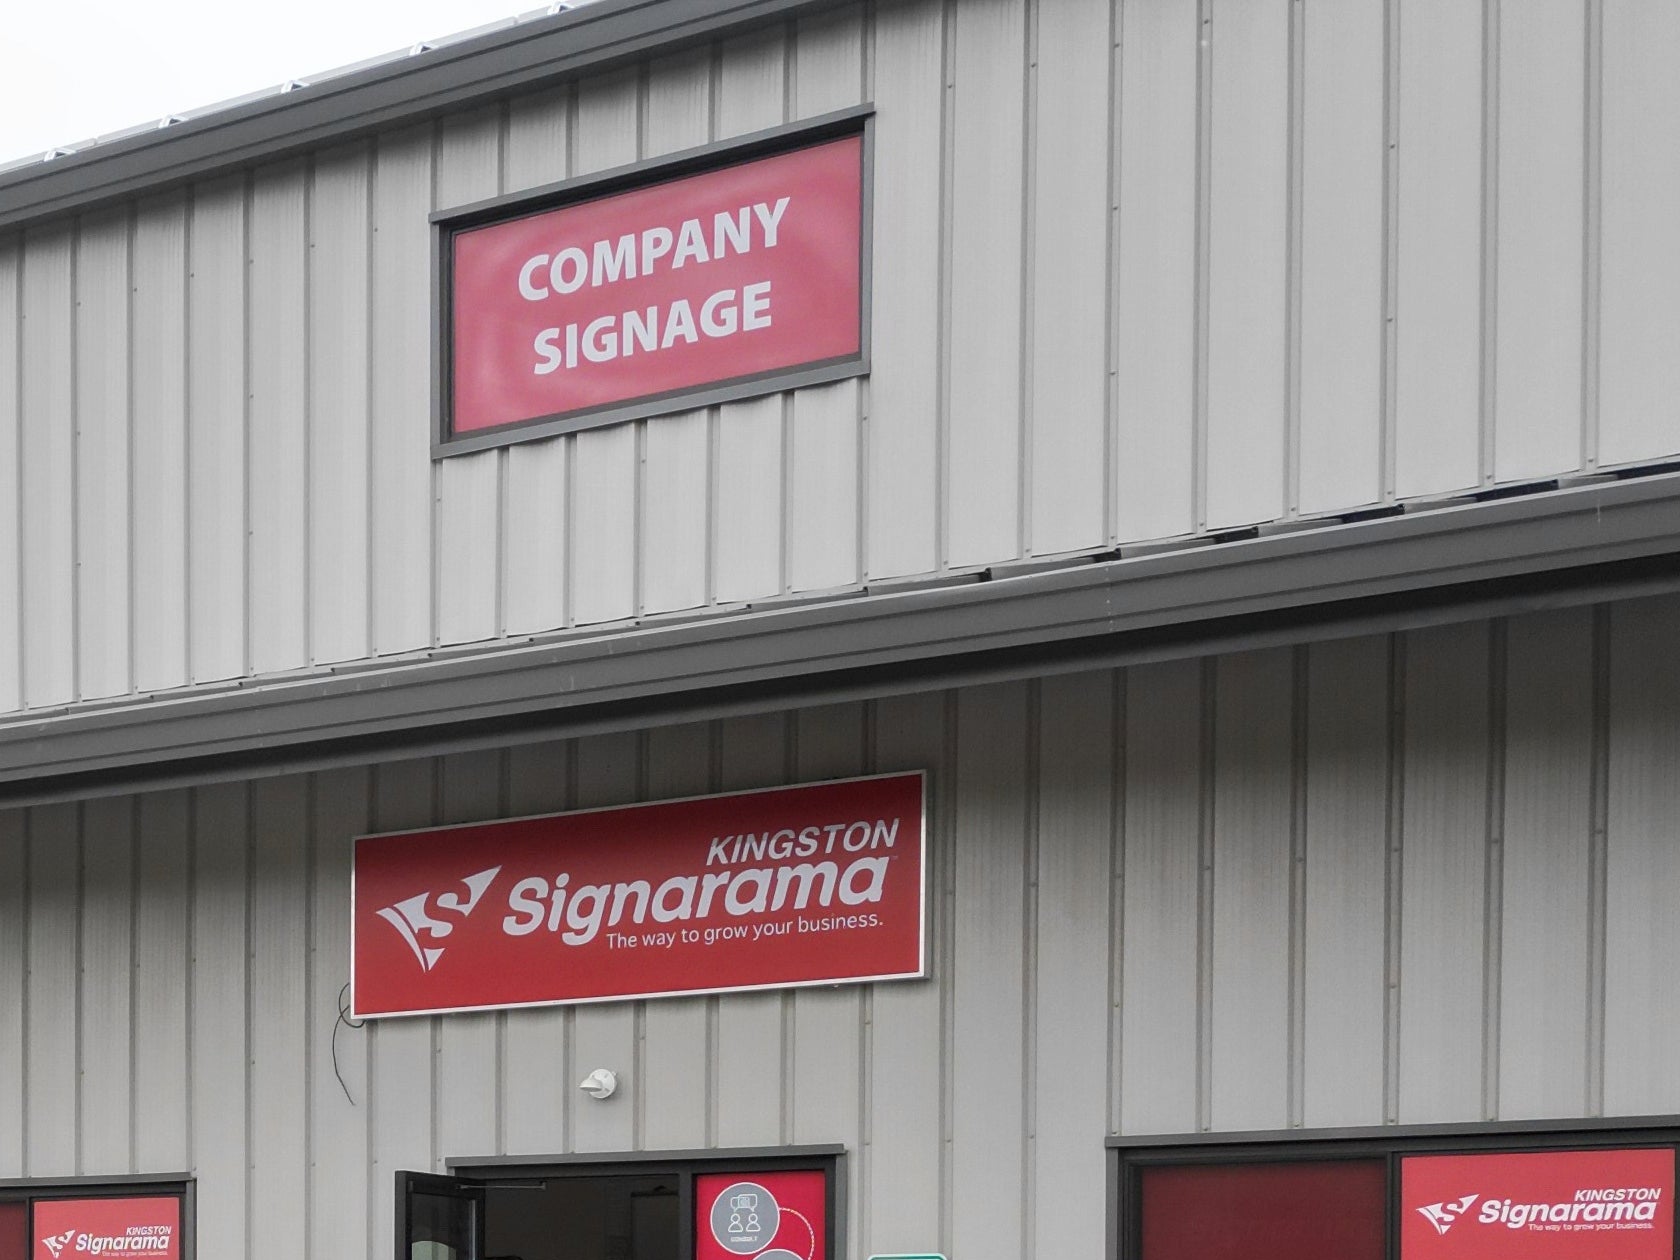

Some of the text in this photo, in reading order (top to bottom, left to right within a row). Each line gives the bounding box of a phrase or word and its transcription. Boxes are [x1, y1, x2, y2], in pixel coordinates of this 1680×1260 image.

[518, 197, 790, 300] COMPANY
[533, 281, 772, 375] SIGNAGE
[706, 818, 900, 866] KINGSTON
[502, 856, 890, 946] Signarama
[607, 913, 883, 949] The way to grow your business.
[1574, 1188, 1662, 1202] KINGSTON
[1478, 1199, 1657, 1228] Signarama
[1528, 1223, 1543, 1231] The
[75, 1233, 170, 1255] Signarama
[126, 1226, 172, 1236] KINGSTON
